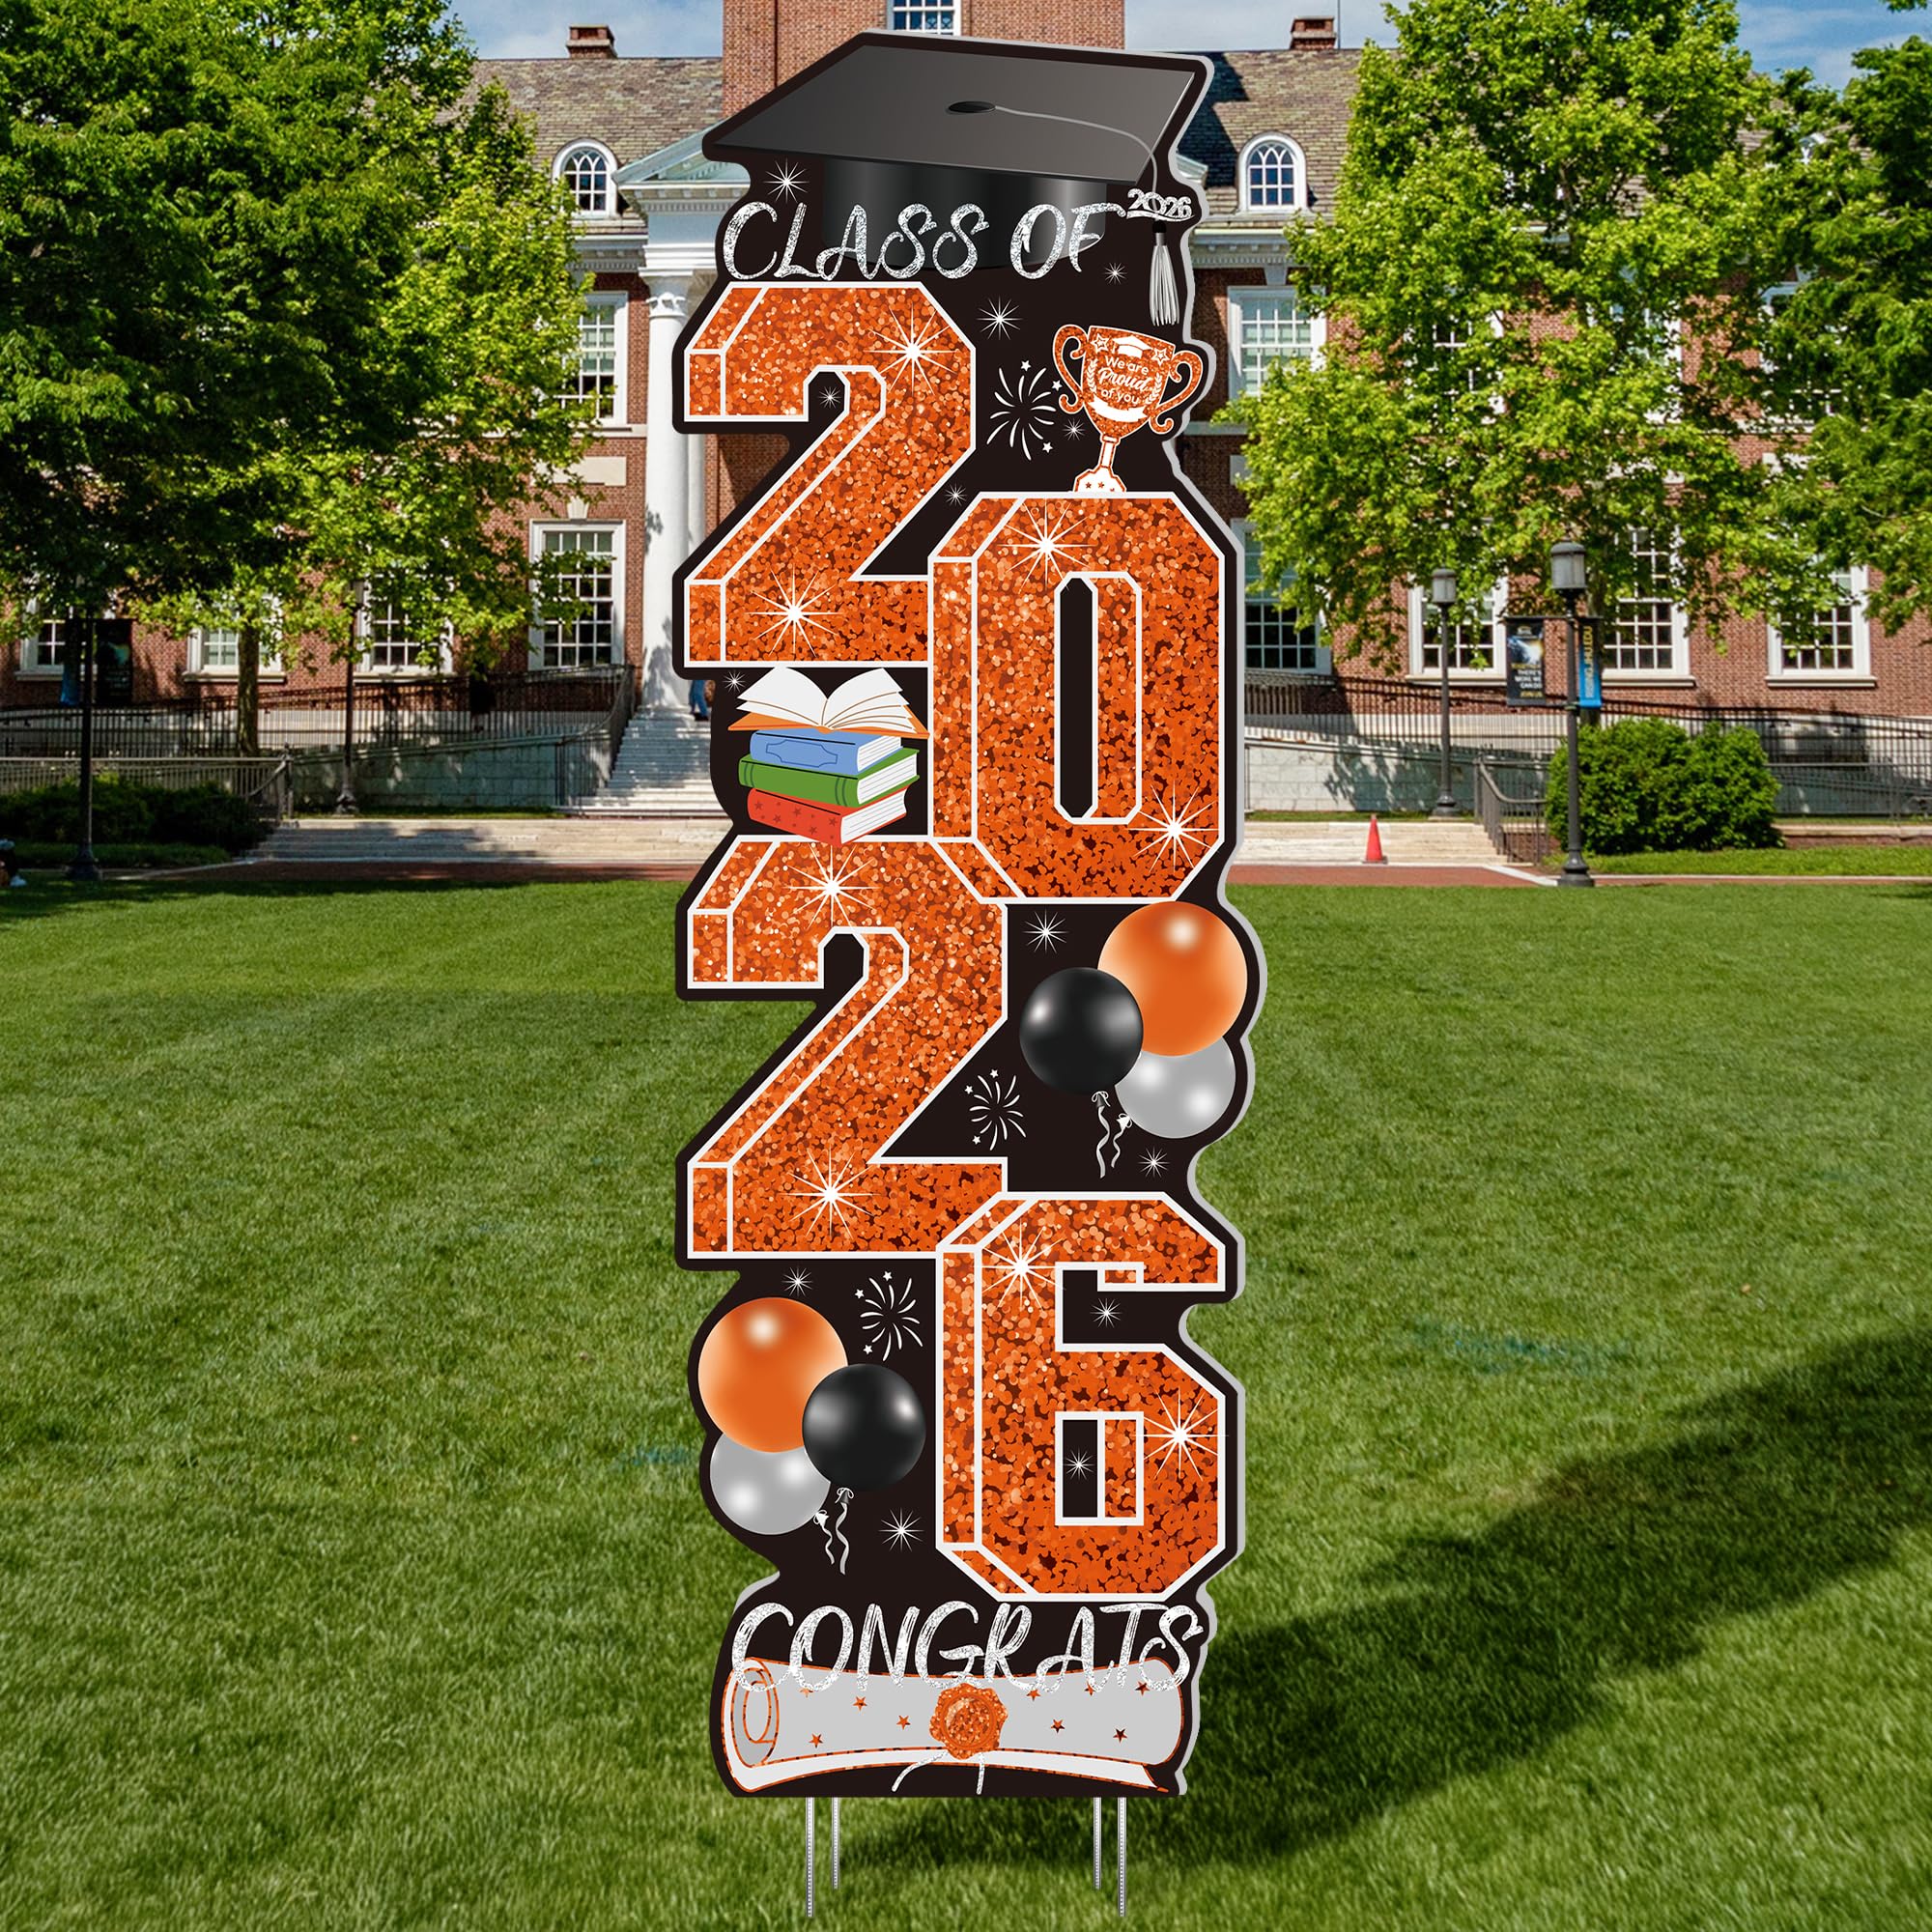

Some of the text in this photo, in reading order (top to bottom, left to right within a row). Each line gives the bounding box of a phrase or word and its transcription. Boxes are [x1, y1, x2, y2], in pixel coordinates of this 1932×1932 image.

[1127, 188, 1193, 219] 2026
[722, 201, 1127, 281] CLASS OF
[1097, 367, 1153, 392] Proud
[1105, 355, 1150, 376] We are
[1101, 388, 1140, 405] of you
[731, 1601, 1205, 1692] CONGRATS
